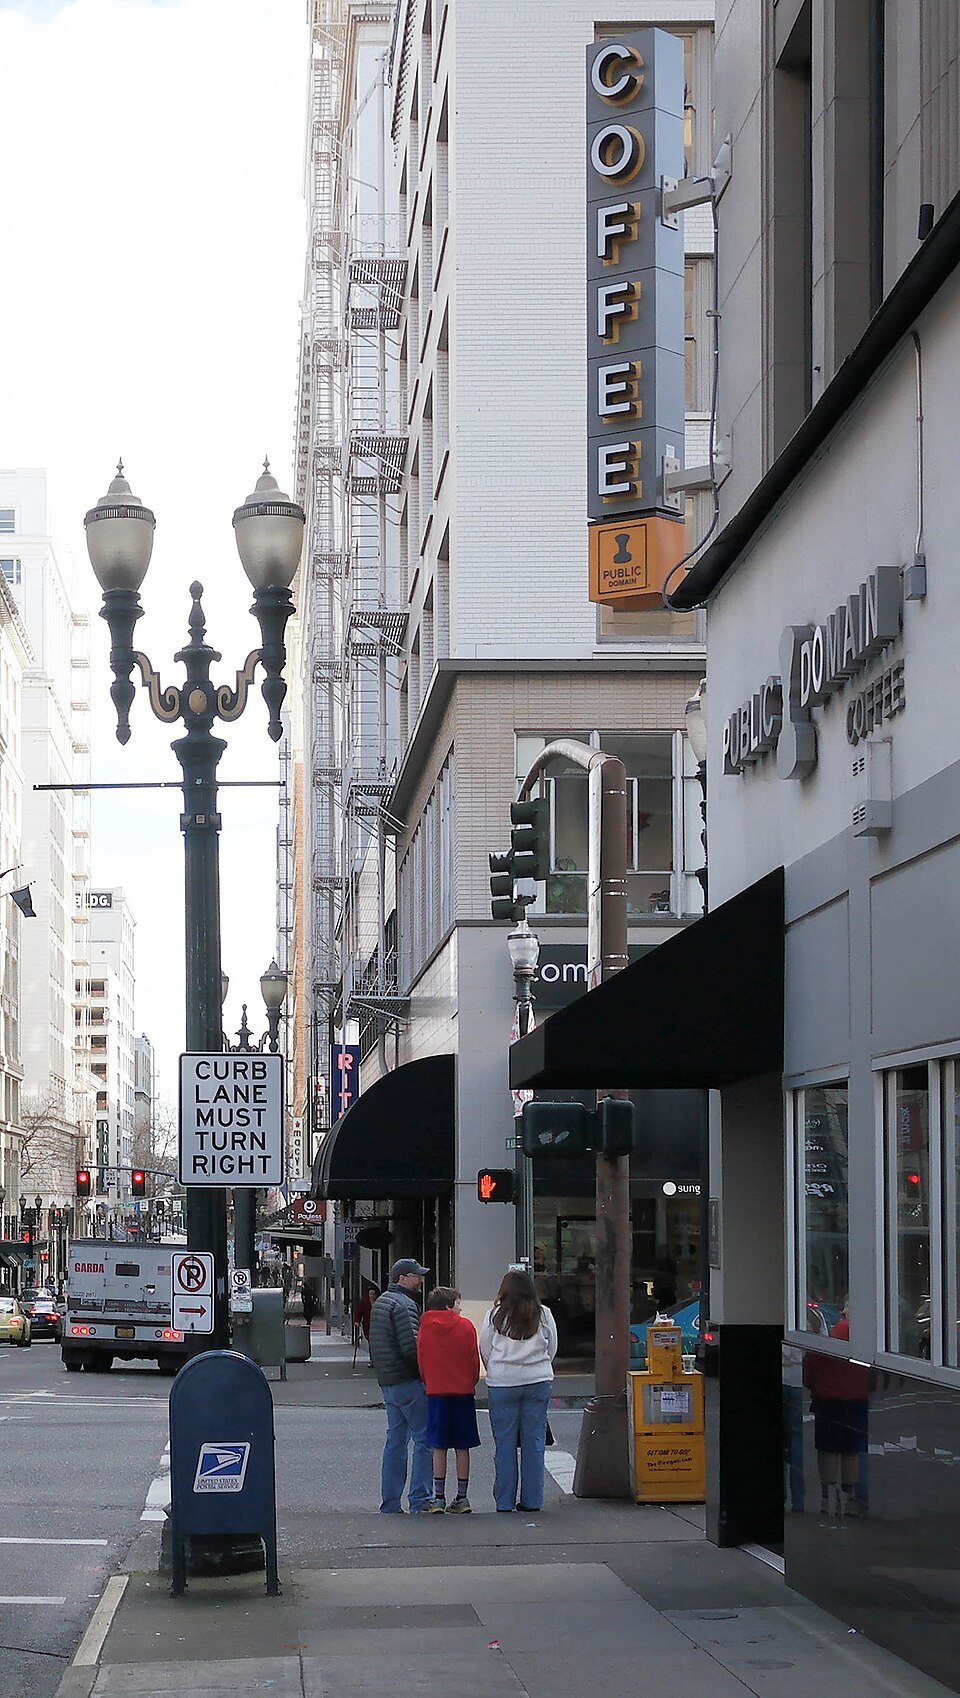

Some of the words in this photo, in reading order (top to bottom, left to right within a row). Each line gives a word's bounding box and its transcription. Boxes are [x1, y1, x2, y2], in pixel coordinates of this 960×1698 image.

[590, 43, 643, 500] COFFEE
[603, 565, 642, 580] PUBLIC
[608, 578, 637, 588] DOMAIN
[800, 566, 900, 708] DOMAIN
[846, 659, 906, 746] COFFEE
[722, 677, 783, 773] PUBLIC
[195, 1060, 267, 1080] CURB
[195, 1084, 268, 1104] LANE
[337, 1053, 354, 1119] RIT
[196, 1107, 267, 1127] MUST
[194, 1131, 266, 1151] TURN
[192, 1154, 272, 1174] RIGHT
[297, 1213, 323, 1221] Payless
[74, 1262, 105, 1274] GARDA
